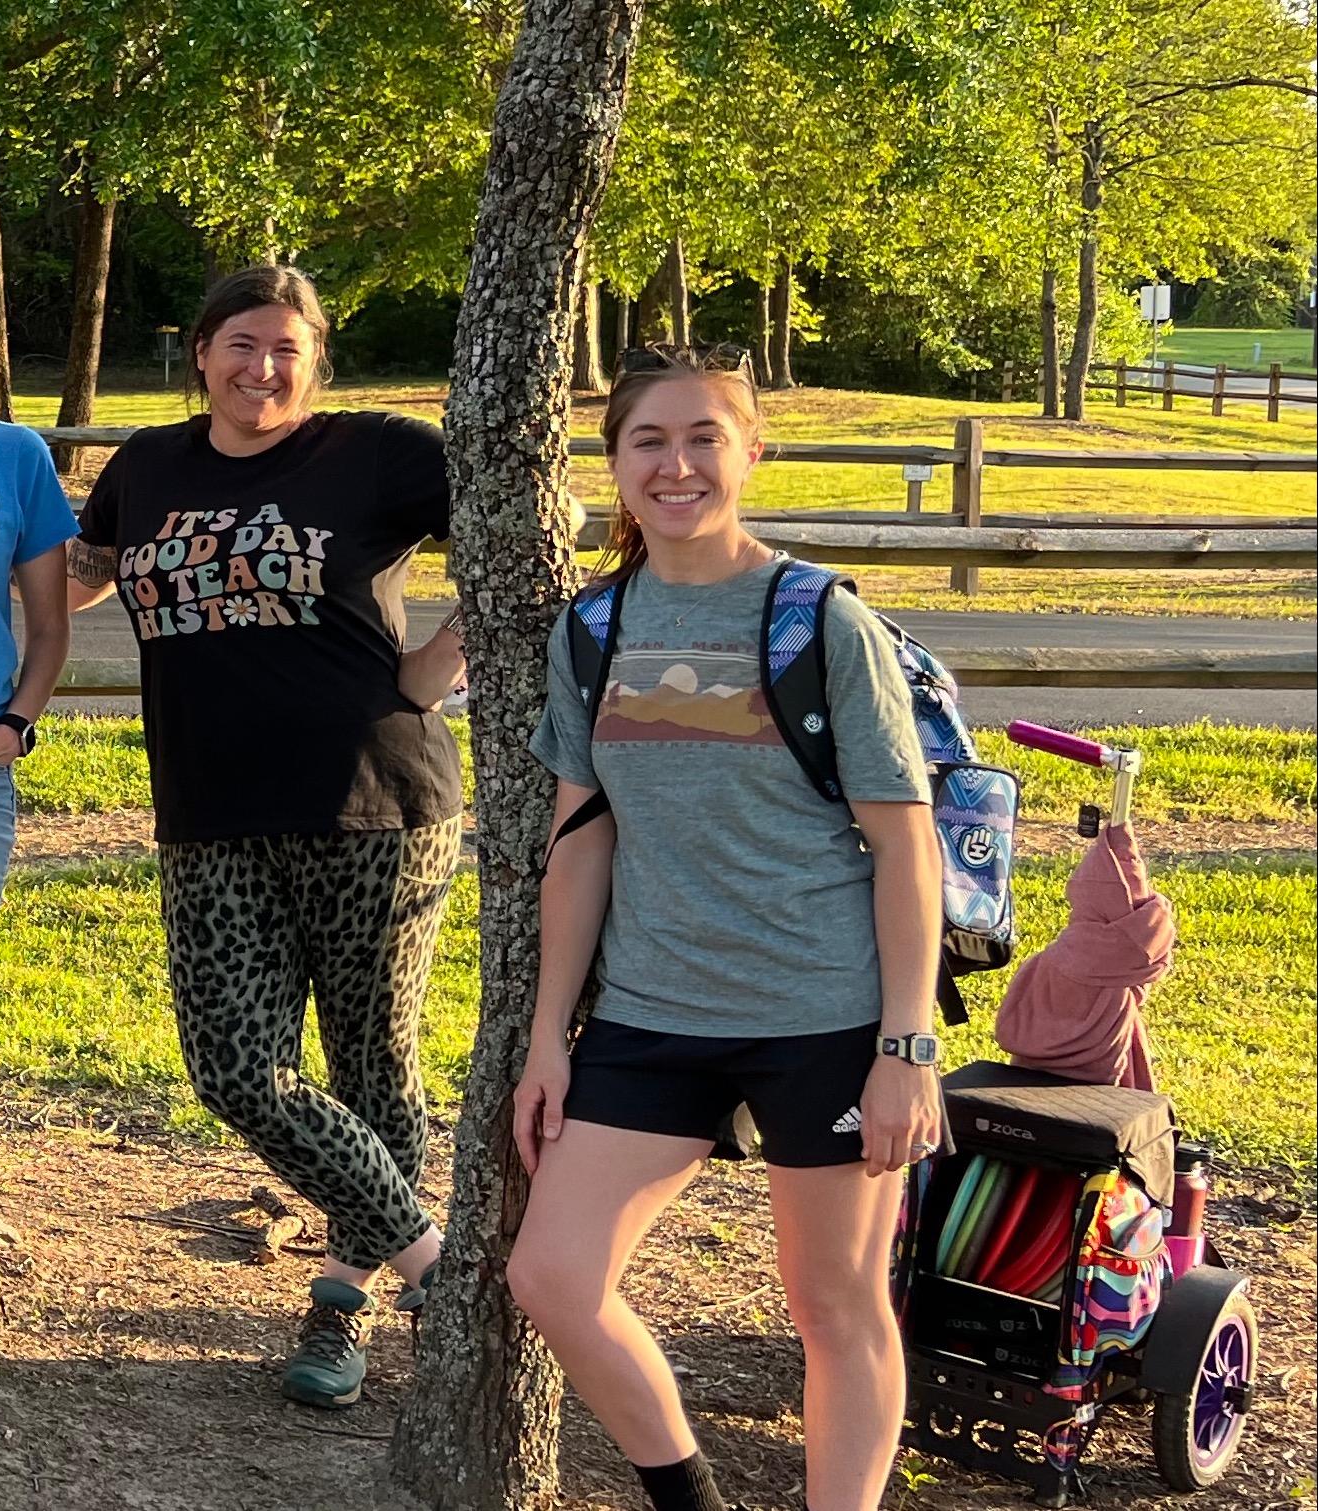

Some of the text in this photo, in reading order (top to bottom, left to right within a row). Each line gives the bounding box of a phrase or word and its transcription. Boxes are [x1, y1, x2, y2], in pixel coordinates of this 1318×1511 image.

[156, 503, 284, 540] IT'S A
[119, 524, 334, 579] GOOD DAY
[121, 552, 325, 609] TO TEACH
[832, 1121, 862, 1133] adid
